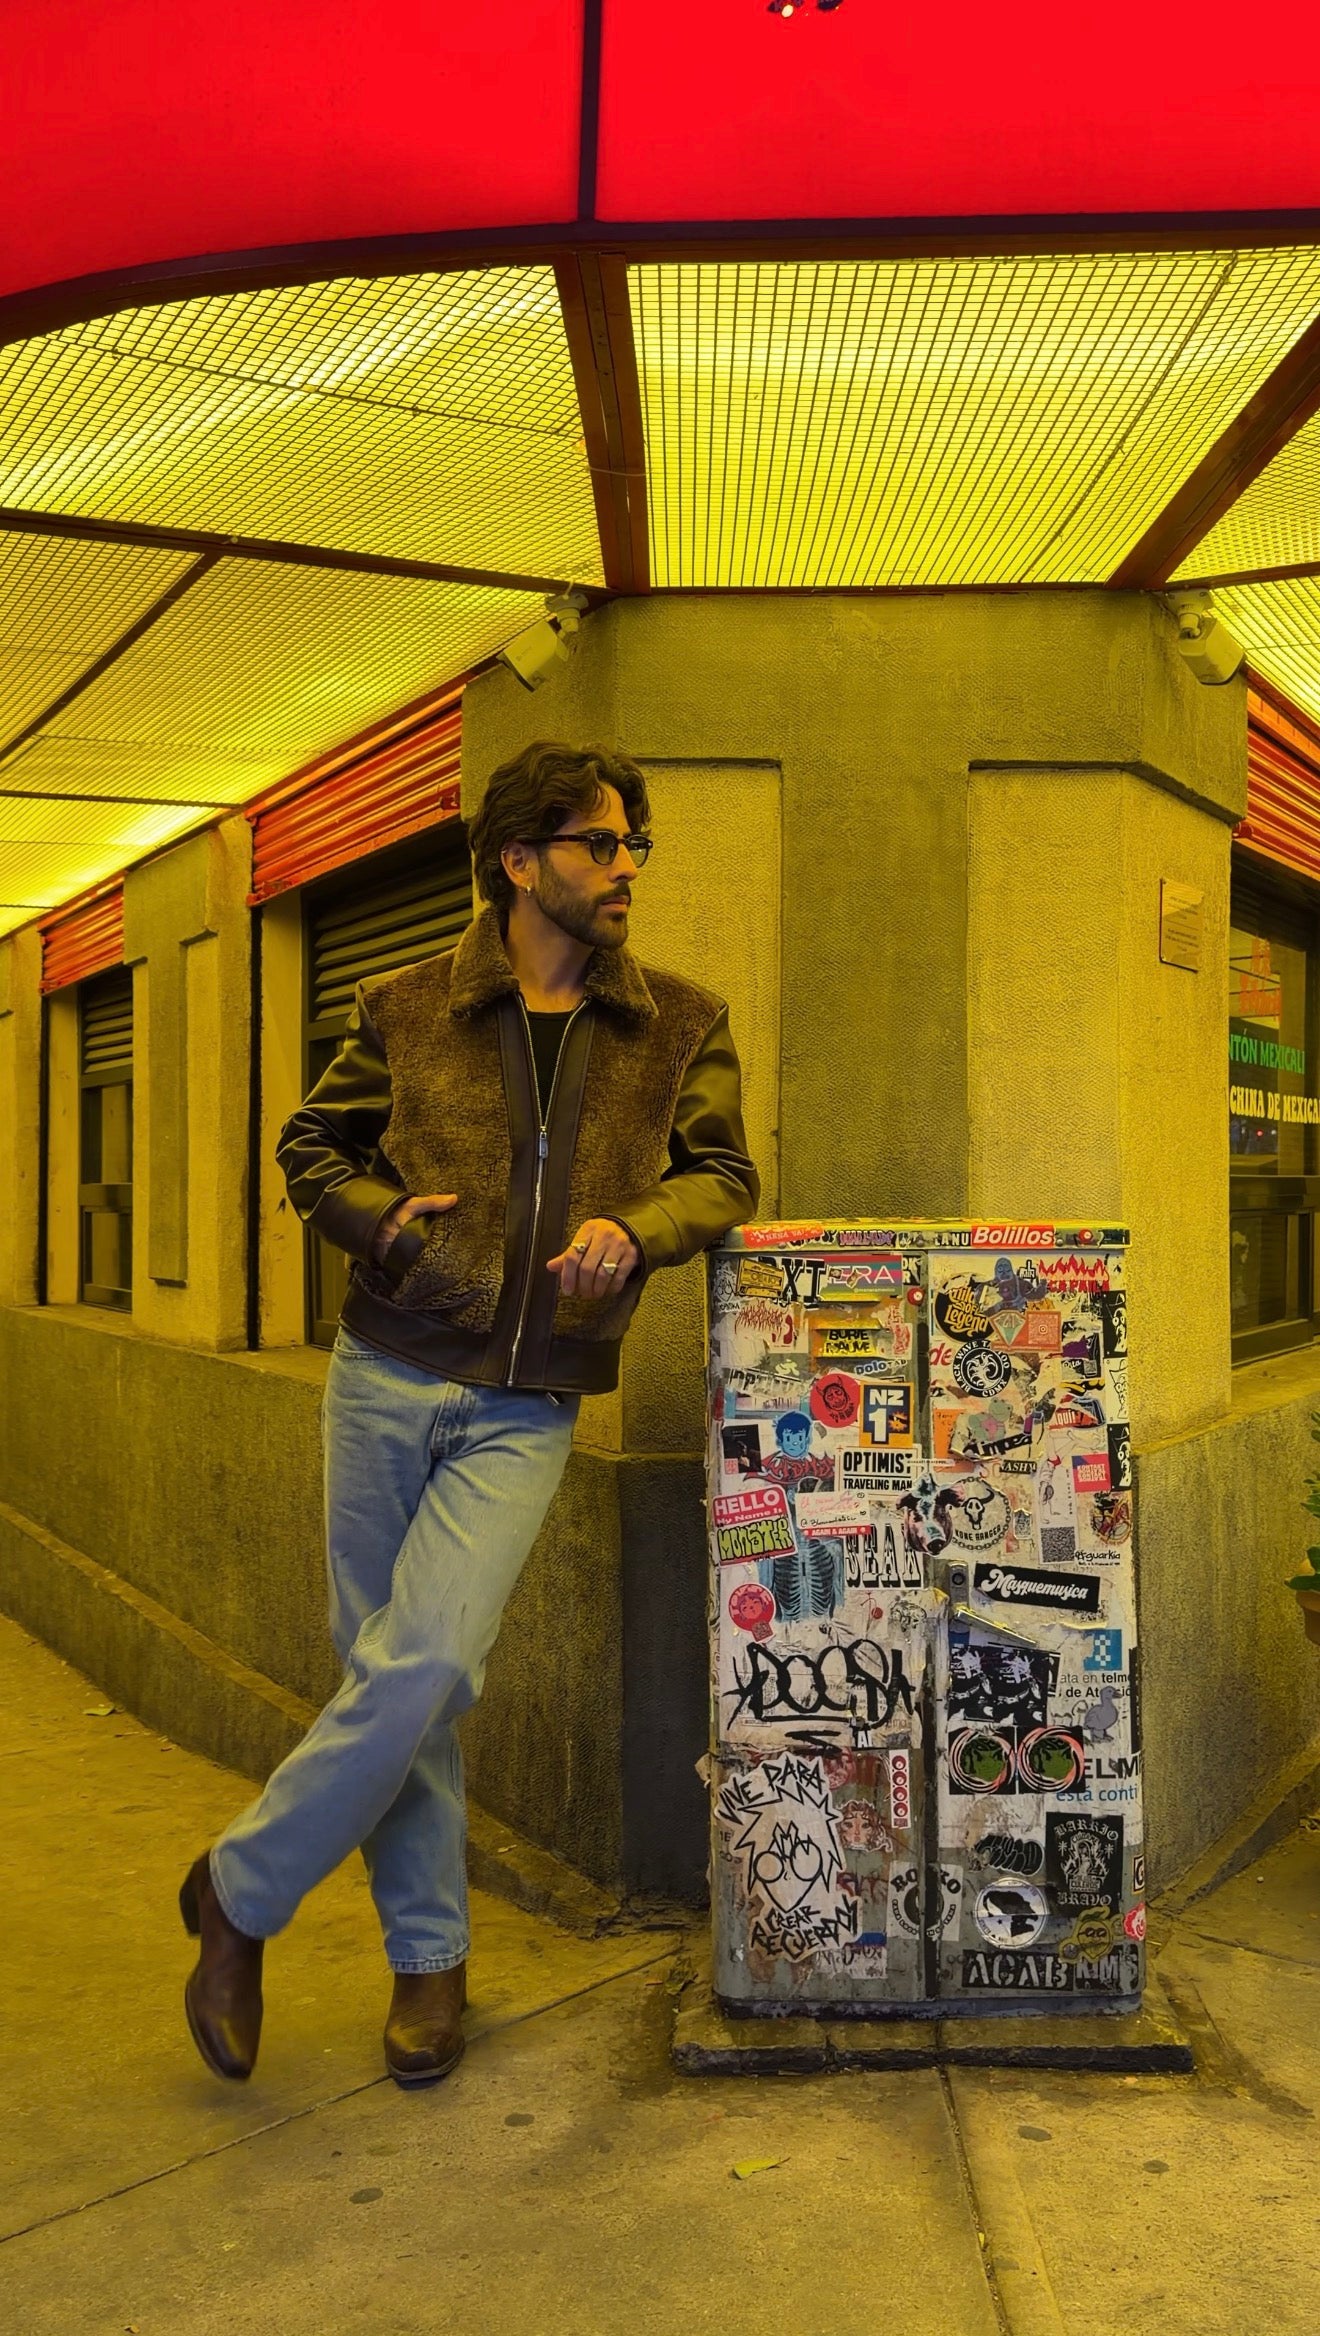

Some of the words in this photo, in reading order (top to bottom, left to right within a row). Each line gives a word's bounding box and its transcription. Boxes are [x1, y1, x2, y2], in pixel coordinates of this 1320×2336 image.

[1260, 1041, 1305, 1074] MEXICALI
[1230, 1085, 1265, 1118] CHINA
[1267, 1092, 1280, 1120] DE
[974, 1226, 1054, 1246] Bolillos
[956, 1341, 979, 1360] WAVE
[868, 1389, 904, 1405] NZ
[981, 1379, 1007, 1397] CDMX
[869, 1408, 887, 1443] 1
[843, 1478, 889, 1490] TRAVELING
[892, 1478, 912, 1491] MAN
[714, 1490, 780, 1516] HELLO
[734, 1510, 771, 1522] Name
[717, 1518, 794, 1561] MONSTER
[981, 1568, 1089, 1601] Masquemusica
[1082, 1674, 1098, 1683] en
[1066, 1687, 1082, 1697] de
[761, 1755, 826, 1795] PARA
[1054, 1820, 1119, 1841] BARRIO
[1056, 1892, 1113, 1907] BRAVO
[765, 1905, 821, 1934] CREAR
[968, 1953, 1067, 1988] ACAB
